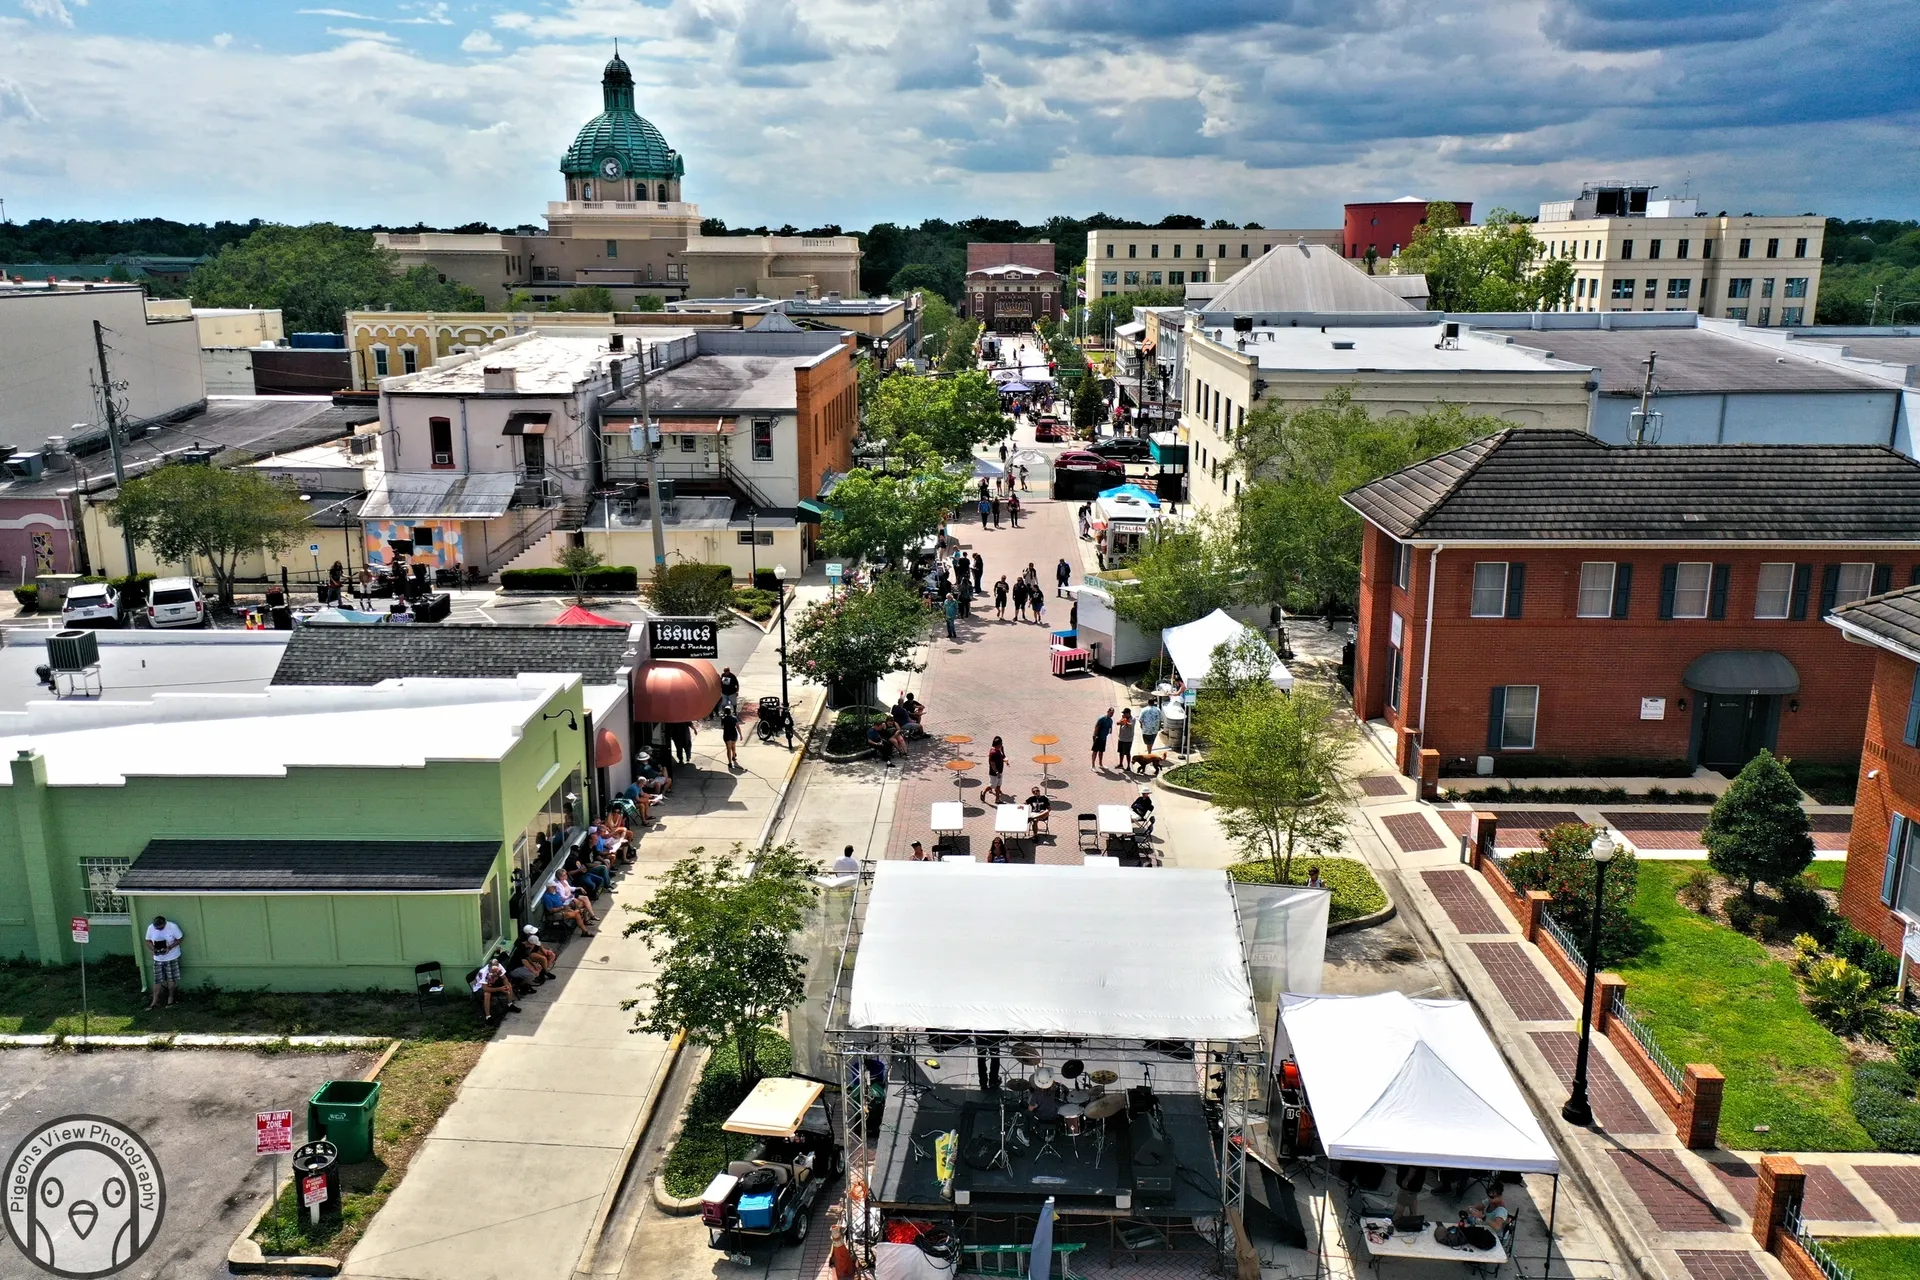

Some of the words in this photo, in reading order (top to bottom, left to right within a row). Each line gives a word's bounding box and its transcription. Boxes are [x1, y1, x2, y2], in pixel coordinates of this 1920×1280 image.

[656, 624, 711, 641] issues
[654, 643, 679, 651] Lounge
[687, 643, 715, 651] Package
[272, 1112, 289, 1120] AWAY
[266, 1120, 282, 1129] ZONE
